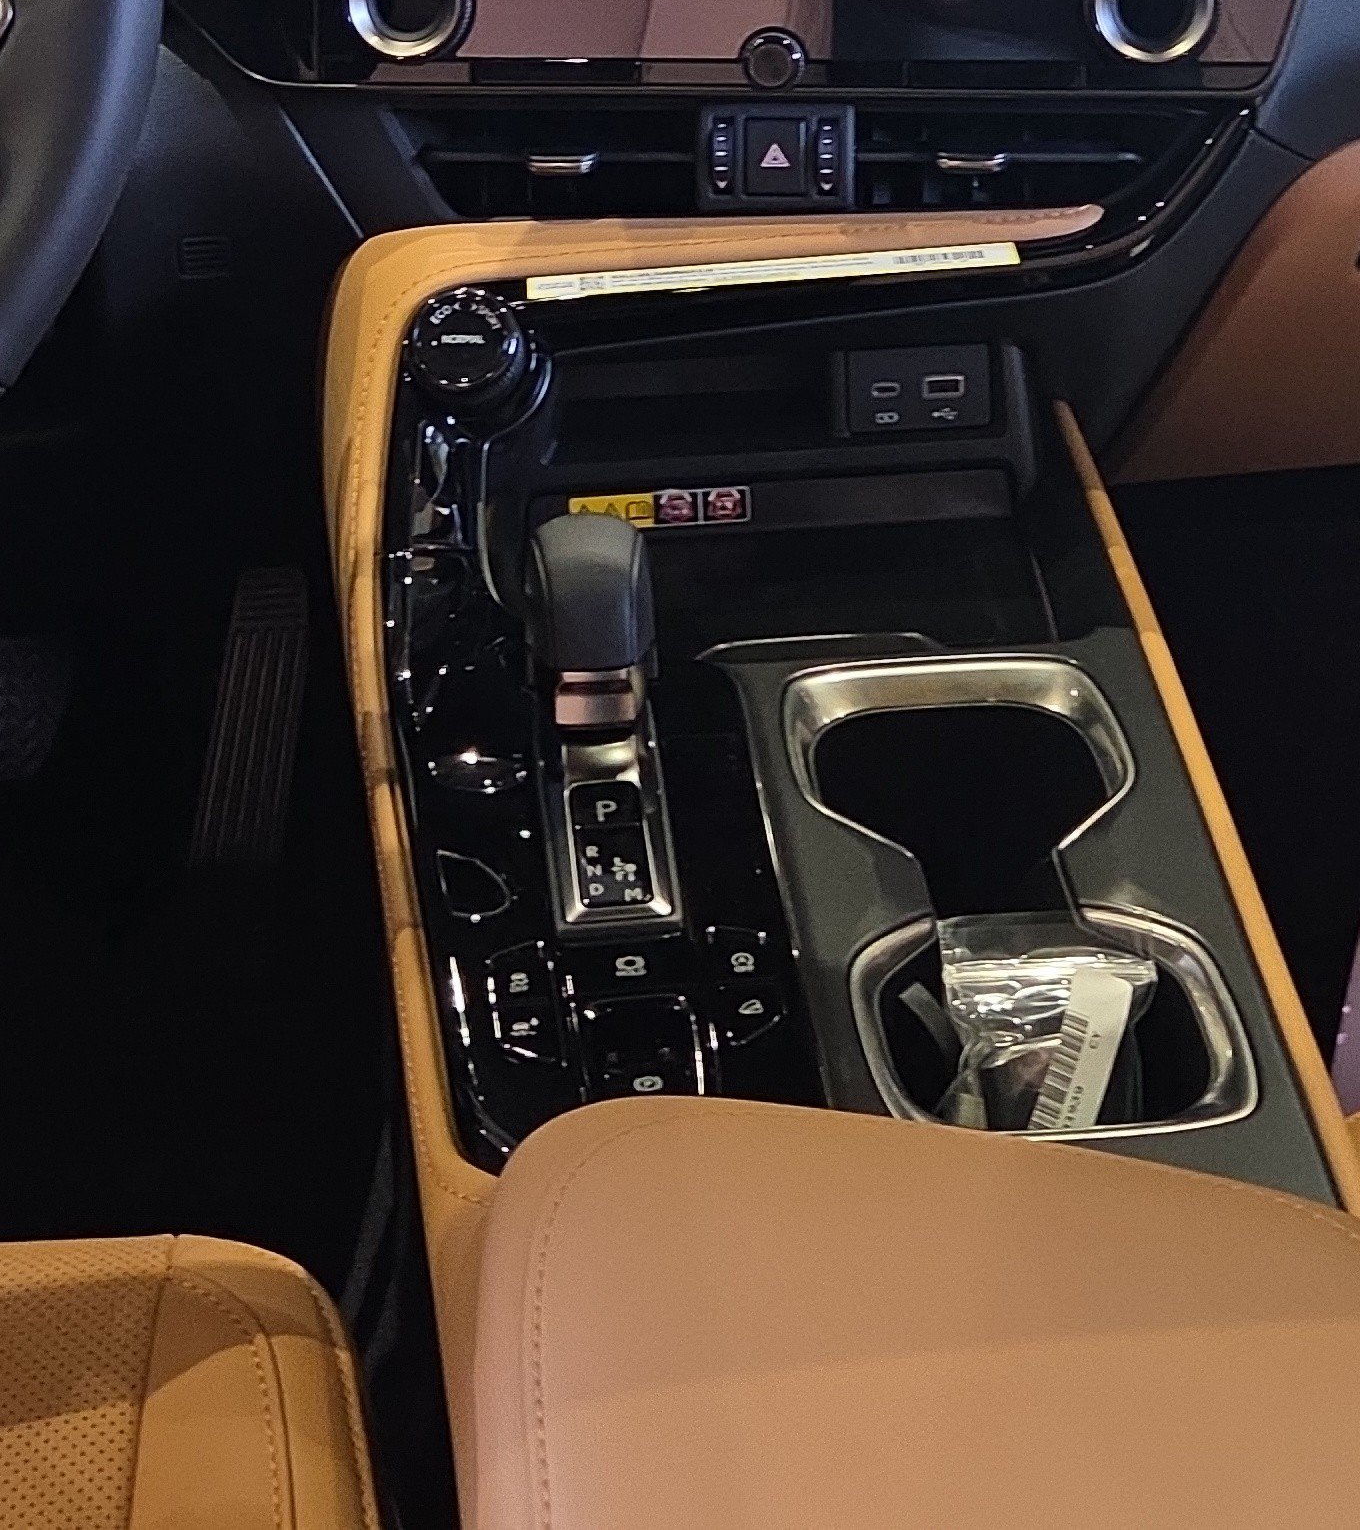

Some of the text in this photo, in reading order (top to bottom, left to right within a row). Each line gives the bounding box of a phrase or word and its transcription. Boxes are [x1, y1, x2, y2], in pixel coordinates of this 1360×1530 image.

[596, 799, 618, 822] P
[585, 845, 599, 859] R
[586, 863, 603, 878] N
[589, 882, 605, 896] D
